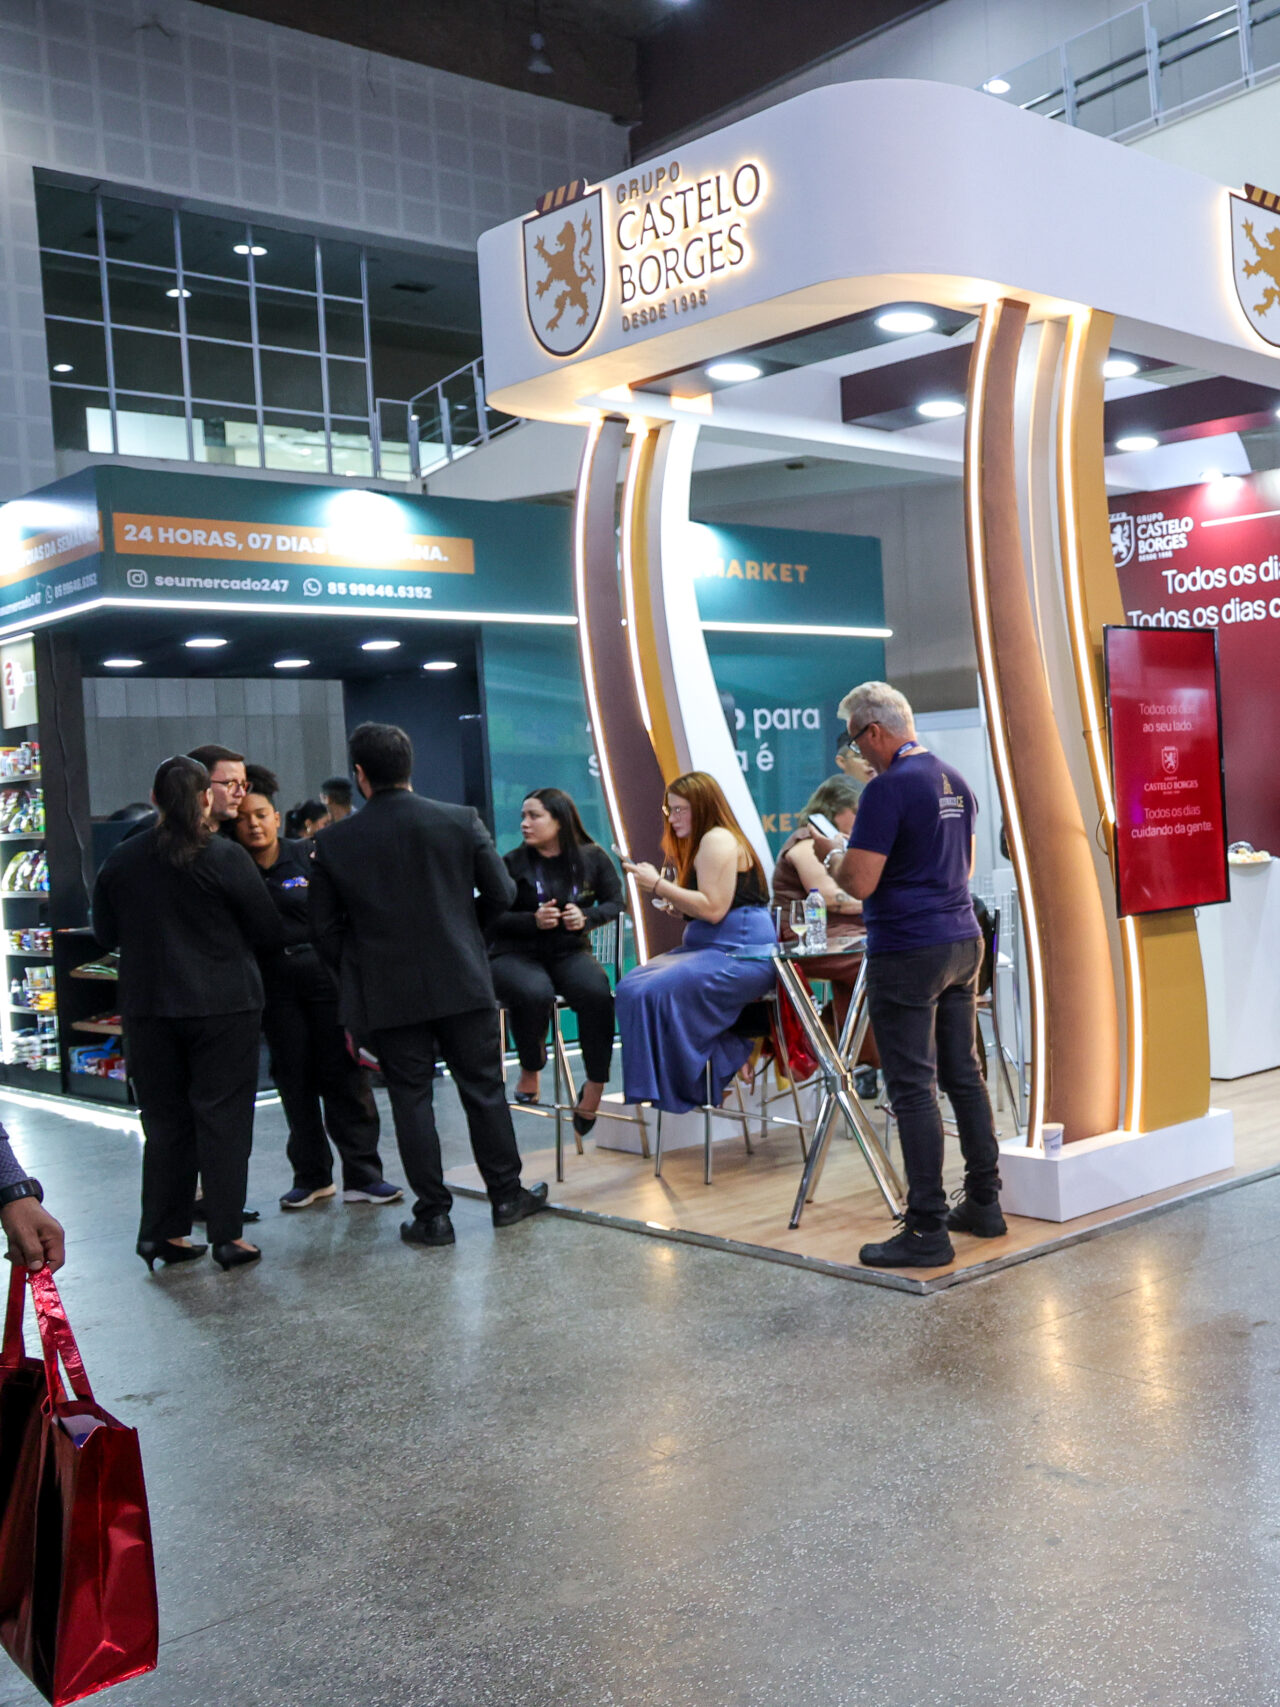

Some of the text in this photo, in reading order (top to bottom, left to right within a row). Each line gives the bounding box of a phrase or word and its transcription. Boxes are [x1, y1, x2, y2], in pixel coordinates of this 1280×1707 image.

[616, 161, 680, 204] GRUPO
[616, 163, 760, 251] CASTELO
[618, 223, 744, 305] BORGES
[622, 288, 707, 332] DESDE 1995
[123, 523, 154, 543] 24
[158, 527, 244, 551] HORAS,
[247, 533, 272, 551] 07
[276, 535, 327, 555] DIAS
[1137, 516, 1194, 539] CASTELO
[1137, 533, 1188, 554] BORGES
[154, 574, 290, 593] seumercado247
[327, 581, 348, 596] 85
[1161, 565, 1227, 595] Todos
[1229, 564, 1257, 586] os
[1126, 606, 1191, 629] Todos
[1193, 605, 1220, 628] os
[1221, 598, 1267, 624] dias
[753, 706, 820, 739] para
[1138, 703, 1166, 716] Todos
[1166, 704, 1177, 715] os
[1143, 722, 1154, 733] ao
[1155, 721, 1172, 733] seu
[756, 742, 775, 771] é
[1143, 780, 1173, 792] CASTELO
[1144, 804, 1201, 820] Todos os dias
[1131, 824, 1174, 839] cuidando
[1174, 822, 1186, 835] da
